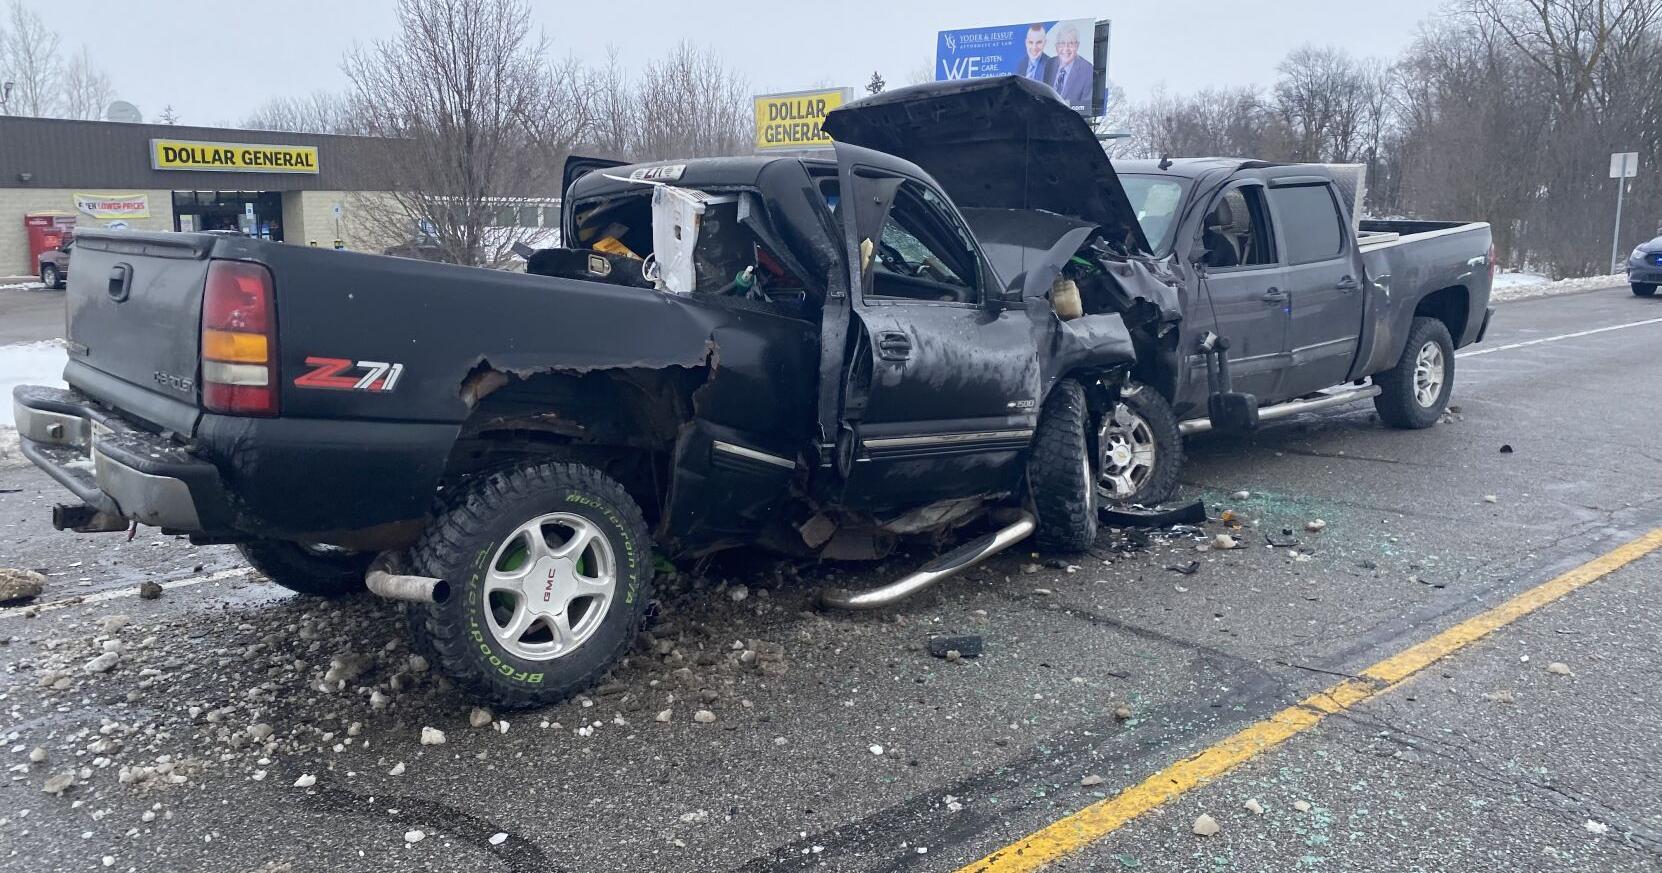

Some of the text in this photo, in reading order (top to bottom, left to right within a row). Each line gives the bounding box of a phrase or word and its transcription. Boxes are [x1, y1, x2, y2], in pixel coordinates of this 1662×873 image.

[960, 33, 982, 42] YODER
[942, 56, 981, 79] WE
[768, 99, 826, 121] DOLLAR
[163, 147, 314, 167] DOLLAR GENERAL
[122, 202, 145, 210] PRICES
[294, 356, 404, 393] Z71
[566, 492, 637, 604] Mud-Terrain T/A
[543, 567, 557, 602] GMC
[467, 573, 545, 684] BFGoodrich
